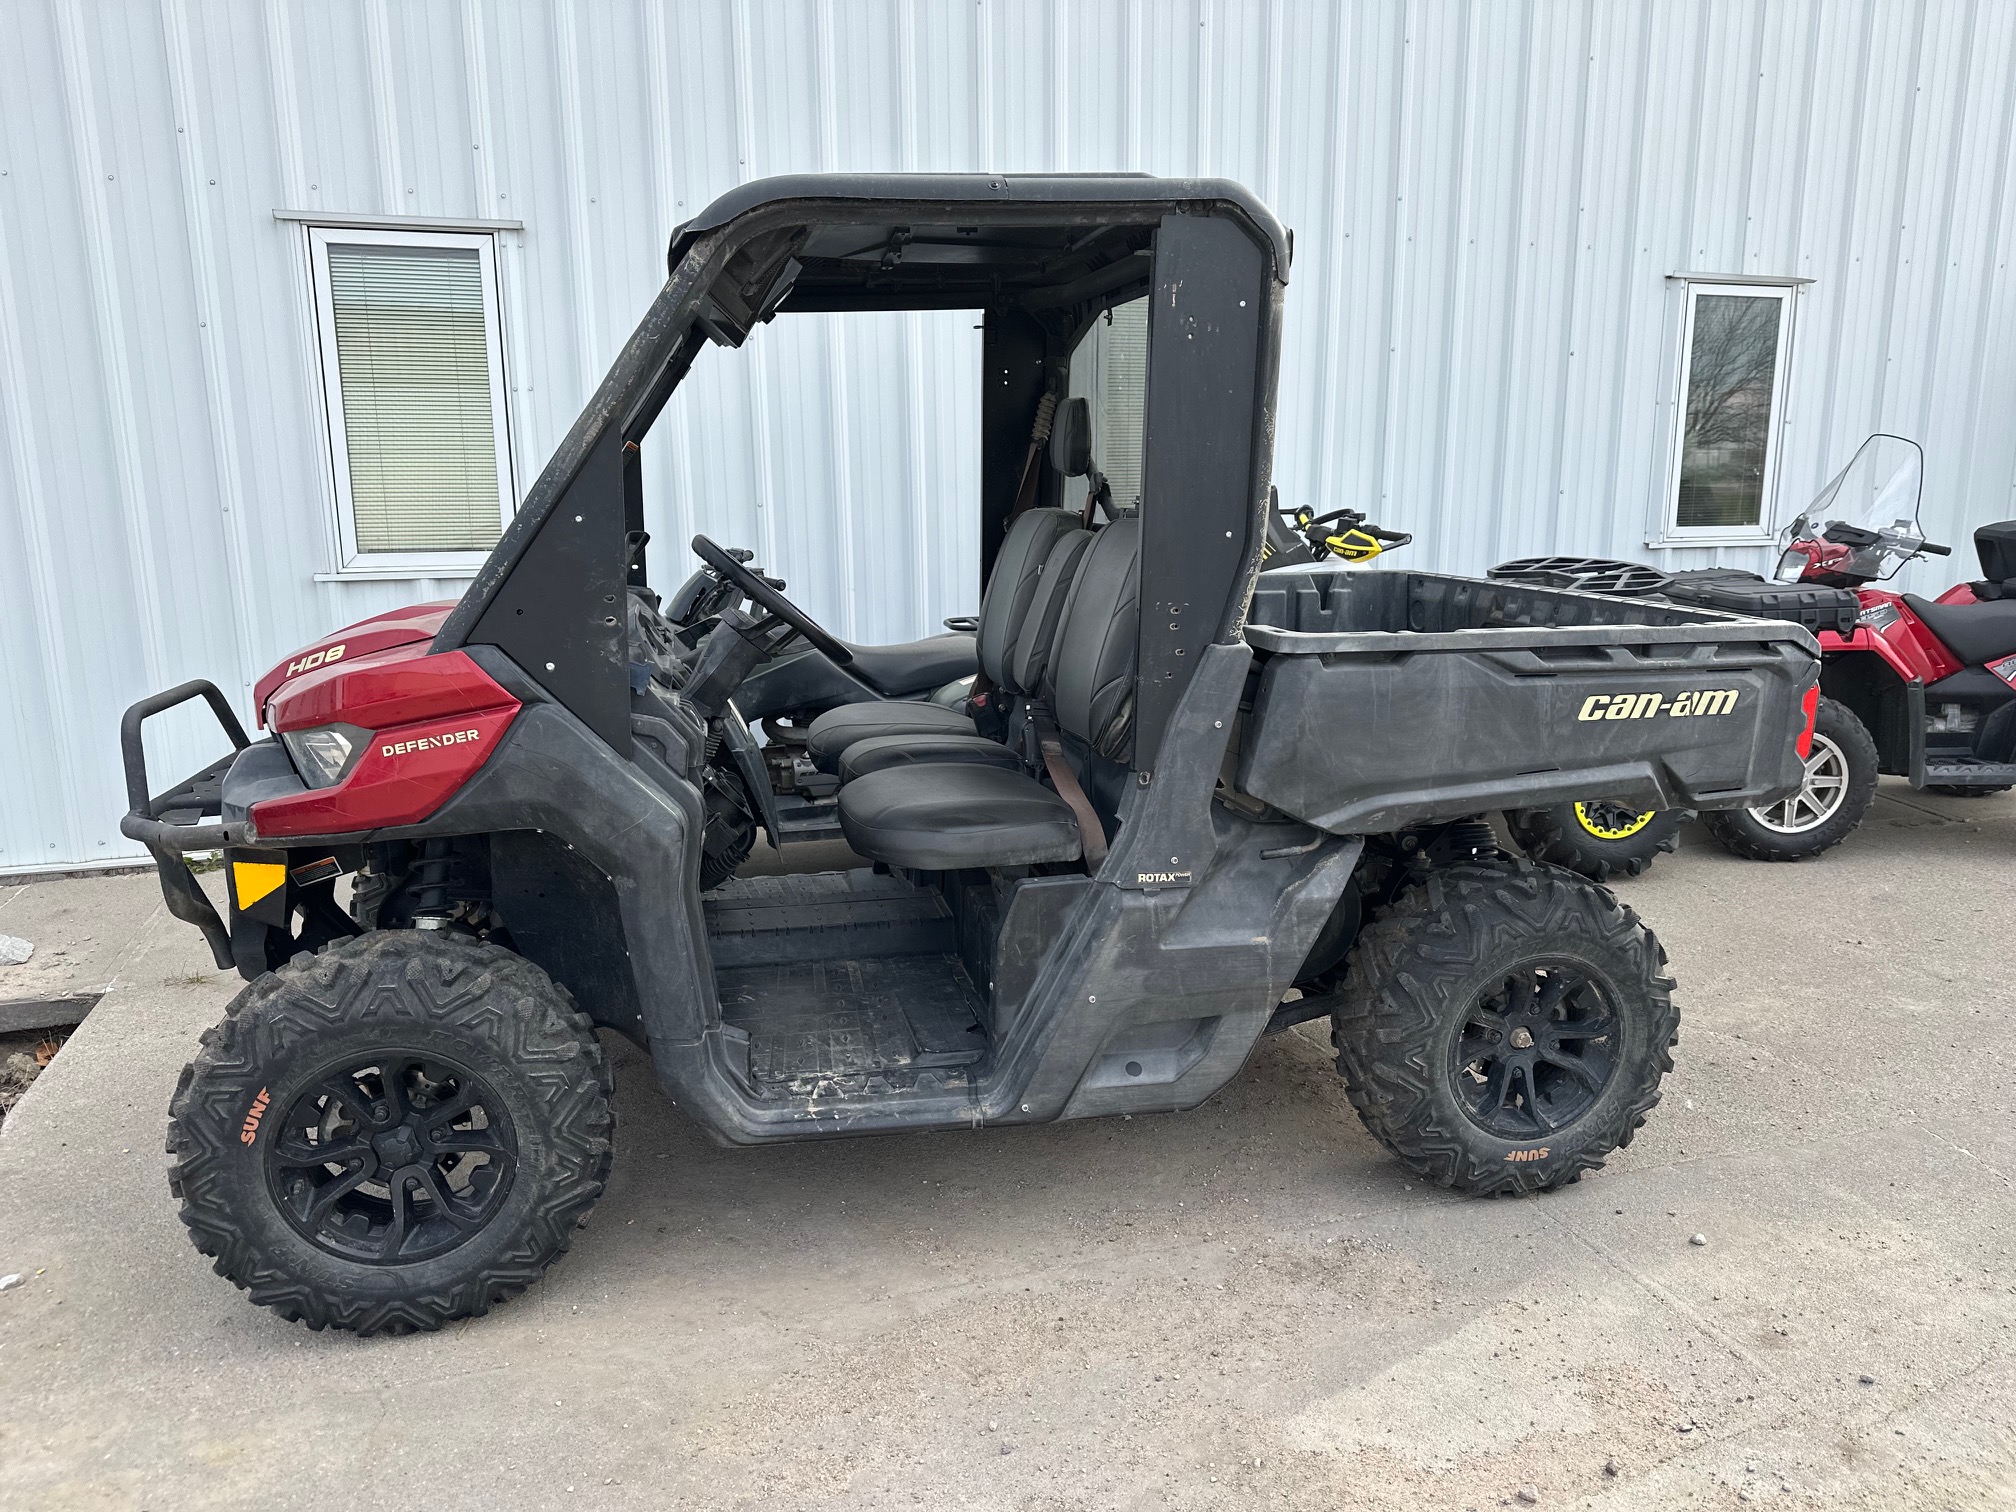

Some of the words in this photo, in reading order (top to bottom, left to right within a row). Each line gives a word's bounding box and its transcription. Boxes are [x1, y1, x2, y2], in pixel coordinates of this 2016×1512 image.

[1860, 601, 1892, 617] RTSMAN
[285, 644, 347, 678] HD8
[1577, 689, 1740, 722] can-am
[381, 729, 480, 758] DEFENDER
[1137, 873, 1176, 883] ROTAX
[240, 1085, 271, 1148] SUNF
[1503, 1147, 1552, 1162] SUNF
